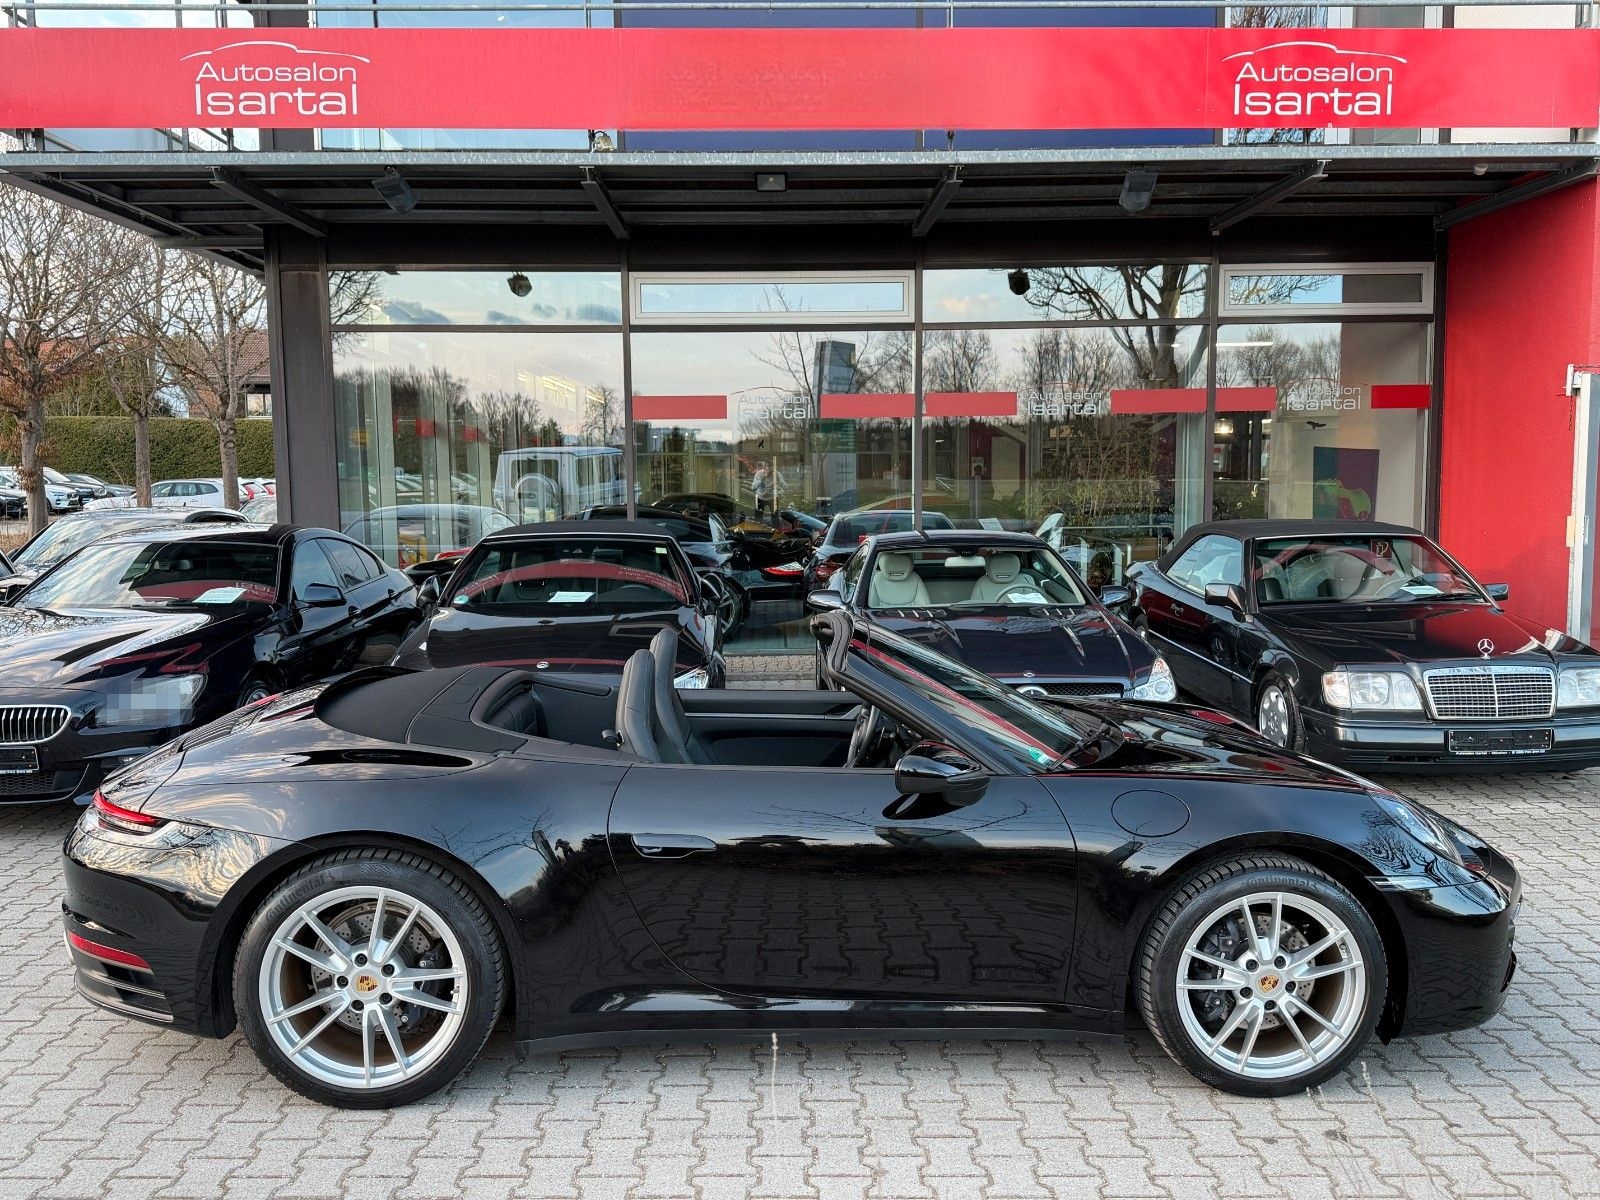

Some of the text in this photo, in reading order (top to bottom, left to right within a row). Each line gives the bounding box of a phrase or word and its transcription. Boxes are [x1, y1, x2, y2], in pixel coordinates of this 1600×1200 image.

[195, 61, 358, 82] Autosalon
[1235, 62, 1393, 82] Autosalon
[194, 83, 358, 116] Isartal
[1233, 83, 1393, 116] Isartal
[1028, 391, 1102, 401] Autosalon
[1286, 395, 1361, 411] Isartal
[1027, 400, 1102, 416] Isartal
